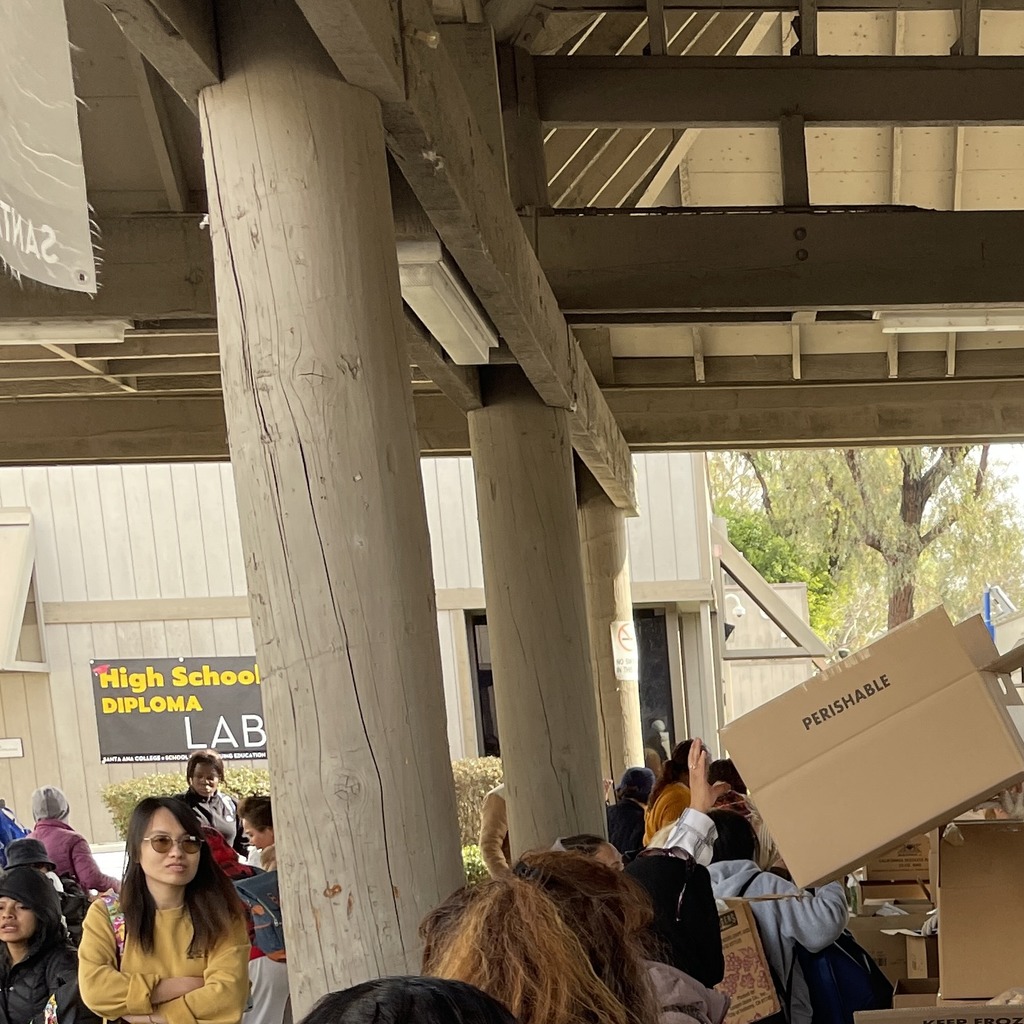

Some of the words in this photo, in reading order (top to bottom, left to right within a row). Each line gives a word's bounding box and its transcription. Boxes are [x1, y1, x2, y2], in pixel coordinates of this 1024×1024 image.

[100, 666, 164, 693] High
[171, 663, 261, 688] School
[102, 695, 203, 714] DIPLOMA
[802, 674, 891, 730] PERISHABLE
[184, 714, 267, 750] LAB
